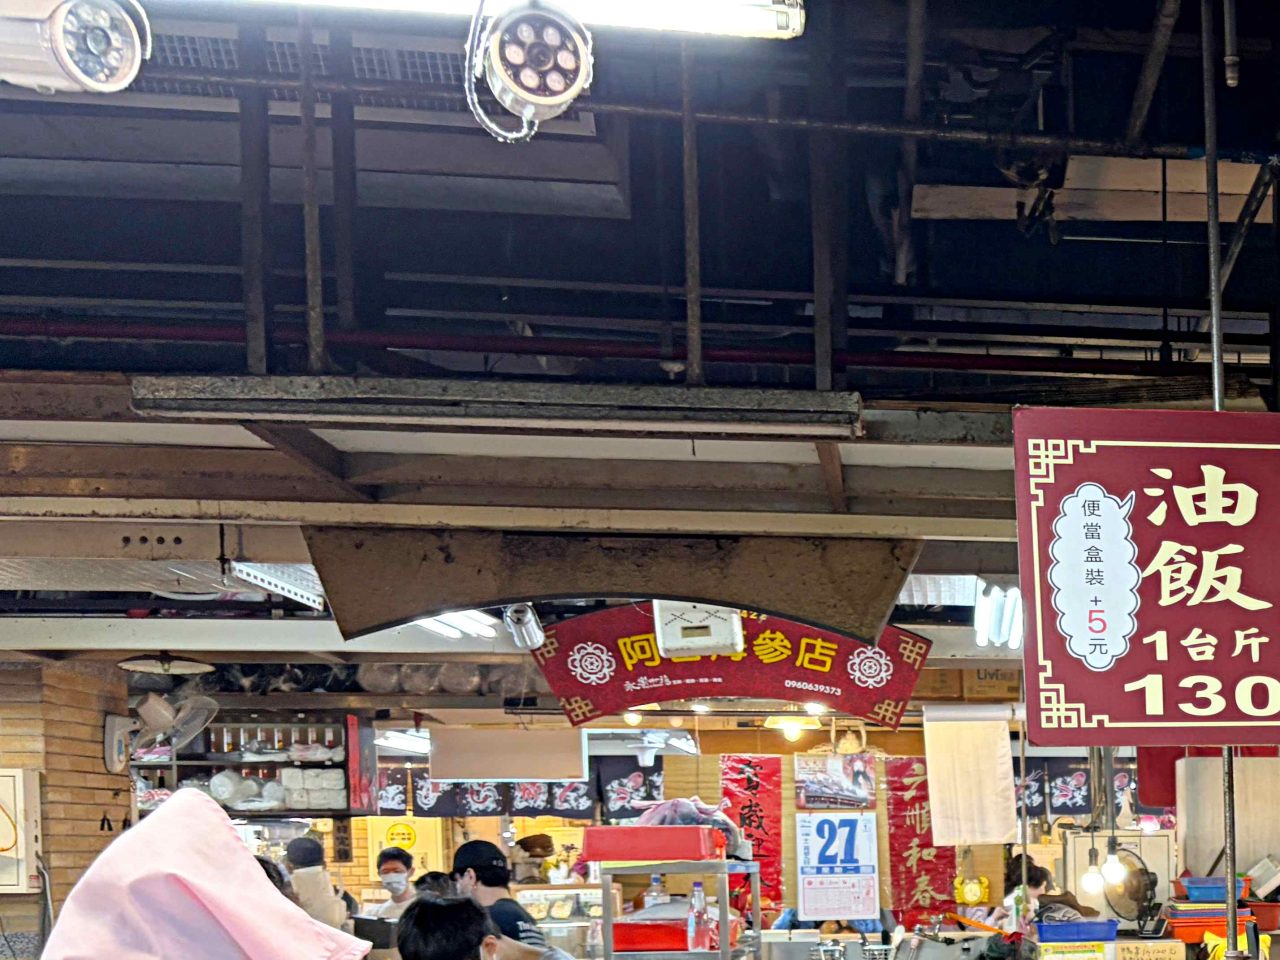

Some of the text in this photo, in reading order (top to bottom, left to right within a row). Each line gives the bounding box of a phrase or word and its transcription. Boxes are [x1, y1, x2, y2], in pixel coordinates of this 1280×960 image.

[1142, 465, 1273, 610] 油飯
[1143, 627, 1271, 664] 1台斤
[816, 818, 859, 865] 27
